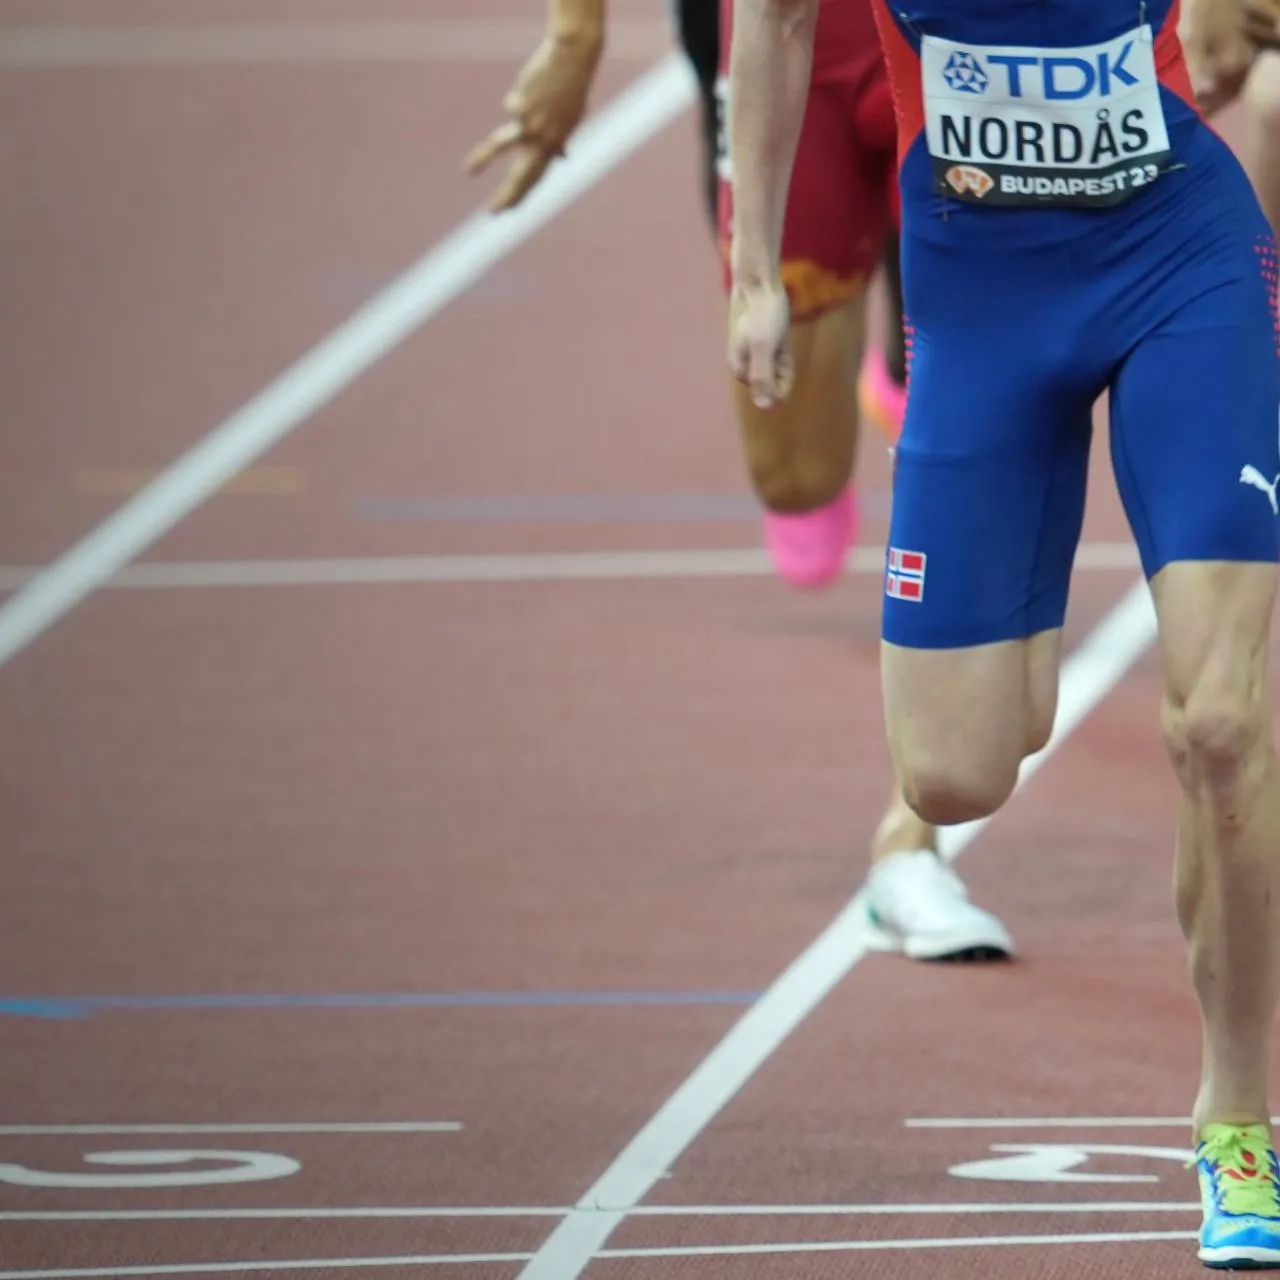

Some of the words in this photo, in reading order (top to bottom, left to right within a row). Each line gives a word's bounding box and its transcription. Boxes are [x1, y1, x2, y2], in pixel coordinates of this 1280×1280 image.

[986, 40, 1141, 101] TDK
[940, 108, 1150, 165] NORDÅS
[999, 169, 1128, 196] BUDAPEST
[1128, 163, 1160, 188] 23
